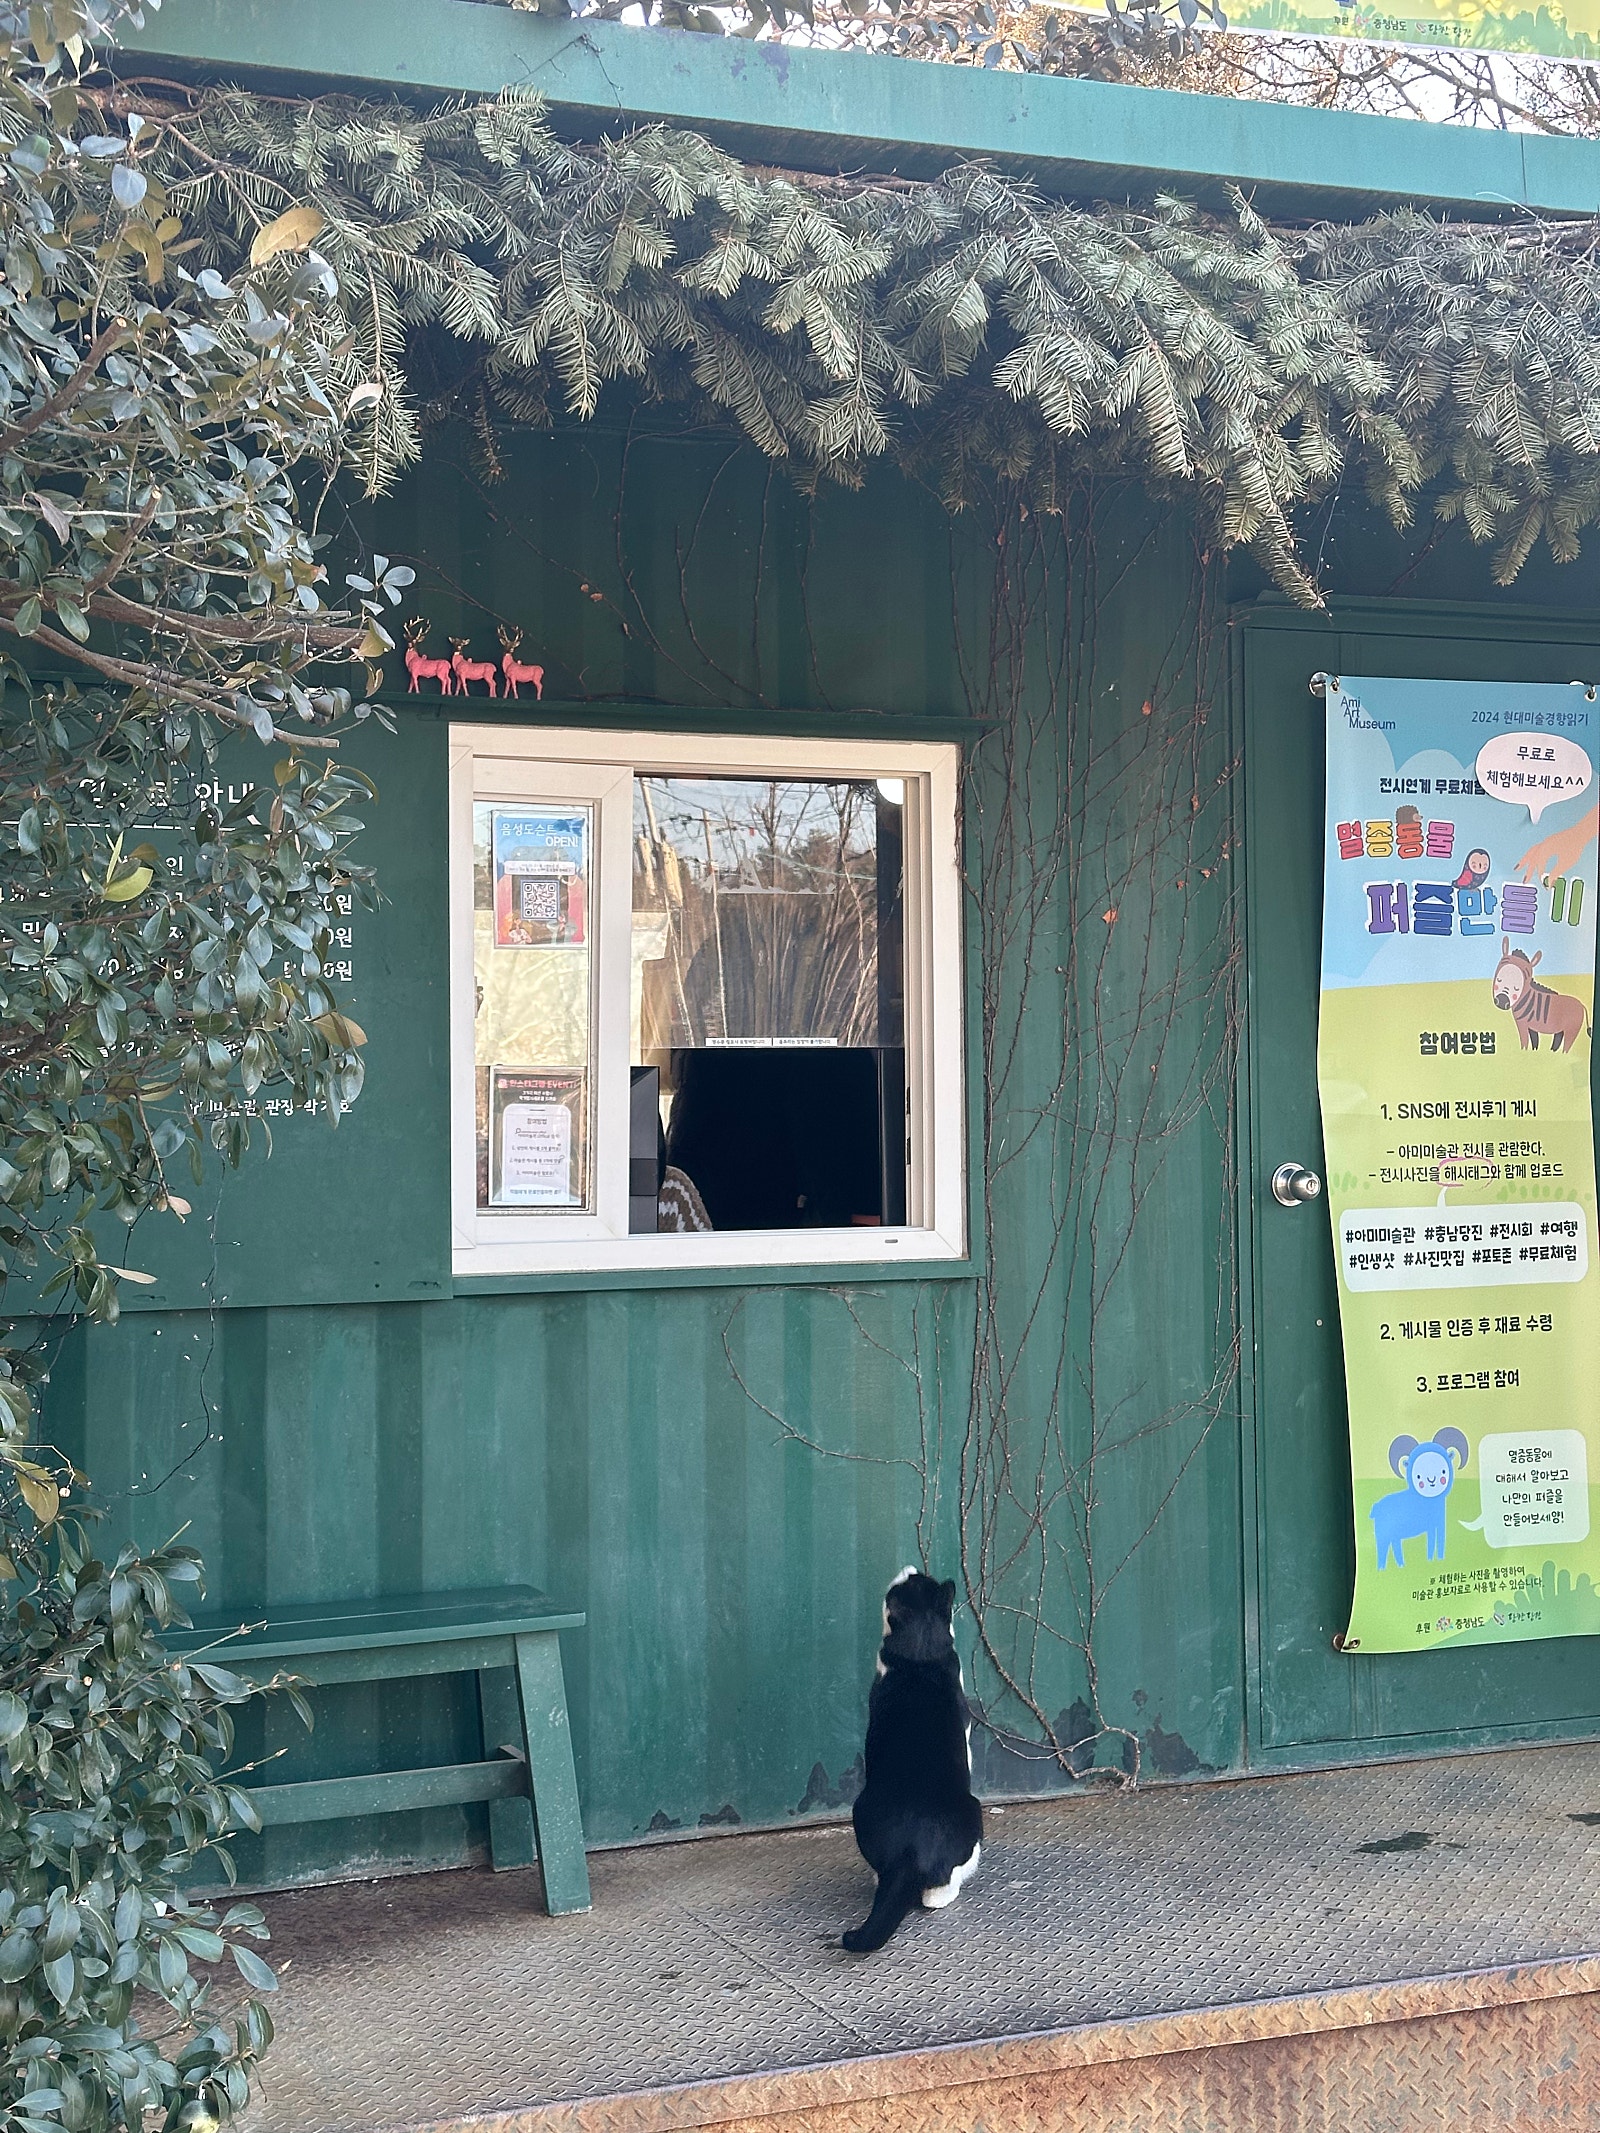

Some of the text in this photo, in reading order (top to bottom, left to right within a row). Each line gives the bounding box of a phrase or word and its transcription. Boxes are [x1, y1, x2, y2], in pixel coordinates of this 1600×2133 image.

[1373, 19, 1407, 31] 충청남도
[1341, 696, 1361, 708] Ami
[1344, 706, 1360, 718] Art
[1472, 711, 1589, 726] 2024 현대미술경향읽기
[1350, 718, 1396, 730] Museum
[1517, 746, 1556, 762] 무료로
[1380, 778, 1431, 794] 전시연계
[1486, 770, 1584, 790] 체험해보세요^^
[500, 823, 557, 836] 음성도슨트
[545, 836, 579, 847] OPEN!
[1337, 821, 1455, 859] 멸종동물
[1366, 876, 1584, 935] 퍼즐만들기
[1420, 1032, 1496, 1055] 참여방법
[1380, 1100, 1537, 1120] 1. SNS에 전시후기 게시
[1398, 1143, 1459, 1159] 아미미술관
[1462, 1142, 1495, 1158] 전시를
[1499, 1141, 1546, 1157] 관람한다.
[1379, 1166, 1440, 1183] 전시사진을
[1444, 1165, 1501, 1181] 해시태그와
[1504, 1164, 1526, 1179] 함께
[1530, 1163, 1564, 1178] 업로드
[1345, 1221, 1579, 1243] #아미미술관 #충남당진 #전시회 #여행
[1349, 1245, 1577, 1270] #인생샷 #사진맛집 #포토존 #무료체험
[1380, 1313, 1553, 1341] 2. 게시물 인증 후 재료 수령
[1416, 1368, 1520, 1393] 3. 프로그램 참여
[1508, 1447, 1553, 1464] 멸종동물에
[1495, 1469, 1570, 1484] 대해서 알아보고
[1502, 1489, 1563, 1505] 나만의 퍼즐을
[1503, 1510, 1564, 1527] 만들어보세양!
[1438, 1571, 1467, 1586] 체험하는
[1469, 1569, 1491, 1582] 사진을
[1493, 1566, 1526, 1579] 촬영하여
[1412, 1577, 1545, 1601] 미술관 홍보자료로 사용할 수 있습니다.
[1455, 1616, 1486, 1630] 충청남도
